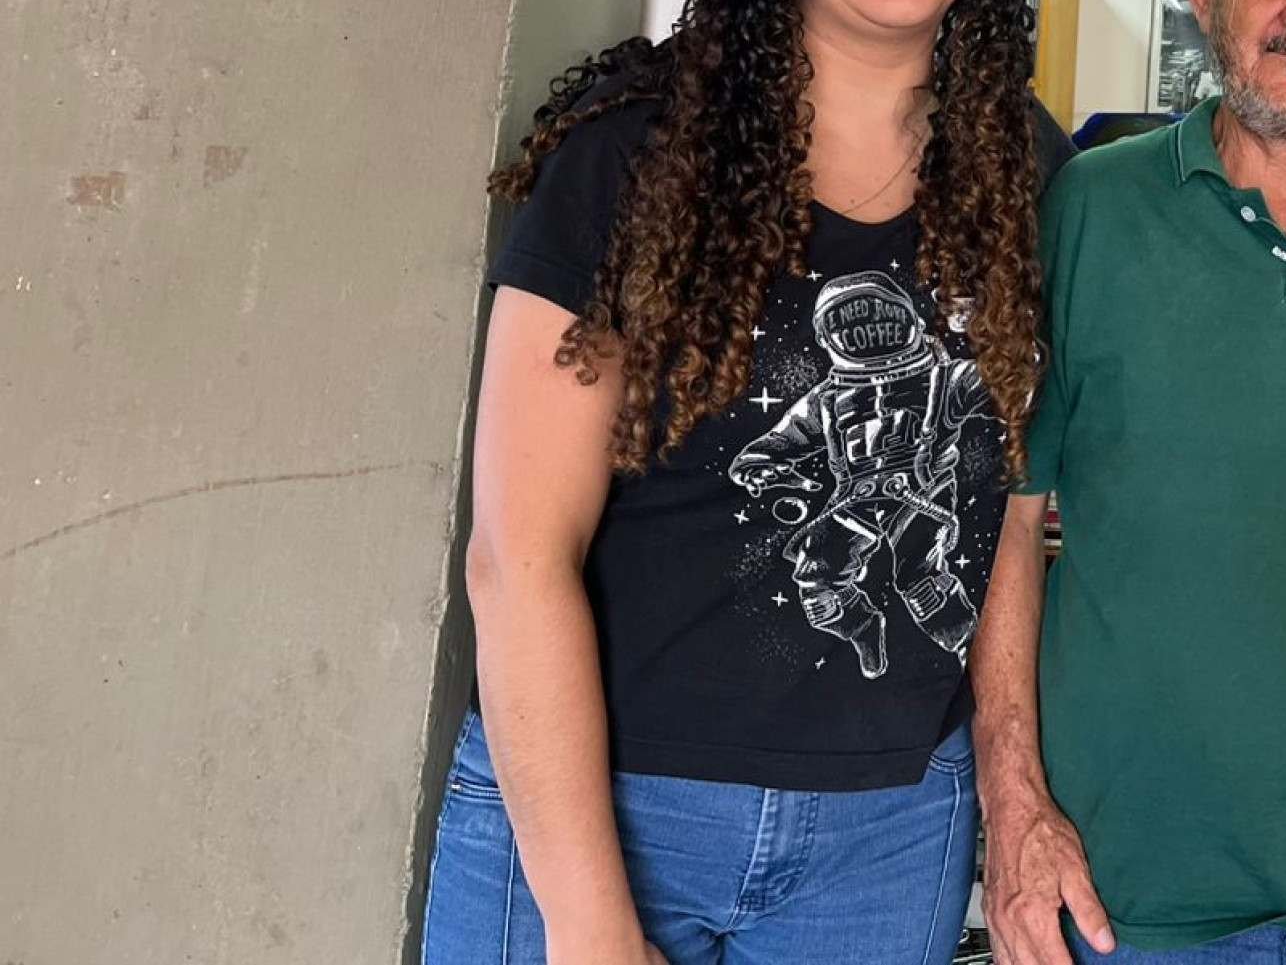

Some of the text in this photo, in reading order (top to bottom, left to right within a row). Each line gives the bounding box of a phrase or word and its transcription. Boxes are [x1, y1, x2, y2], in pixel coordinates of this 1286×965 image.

[828, 311, 837, 329] I
[840, 299, 869, 324] NEED
[842, 323, 903, 351] COFFEE
